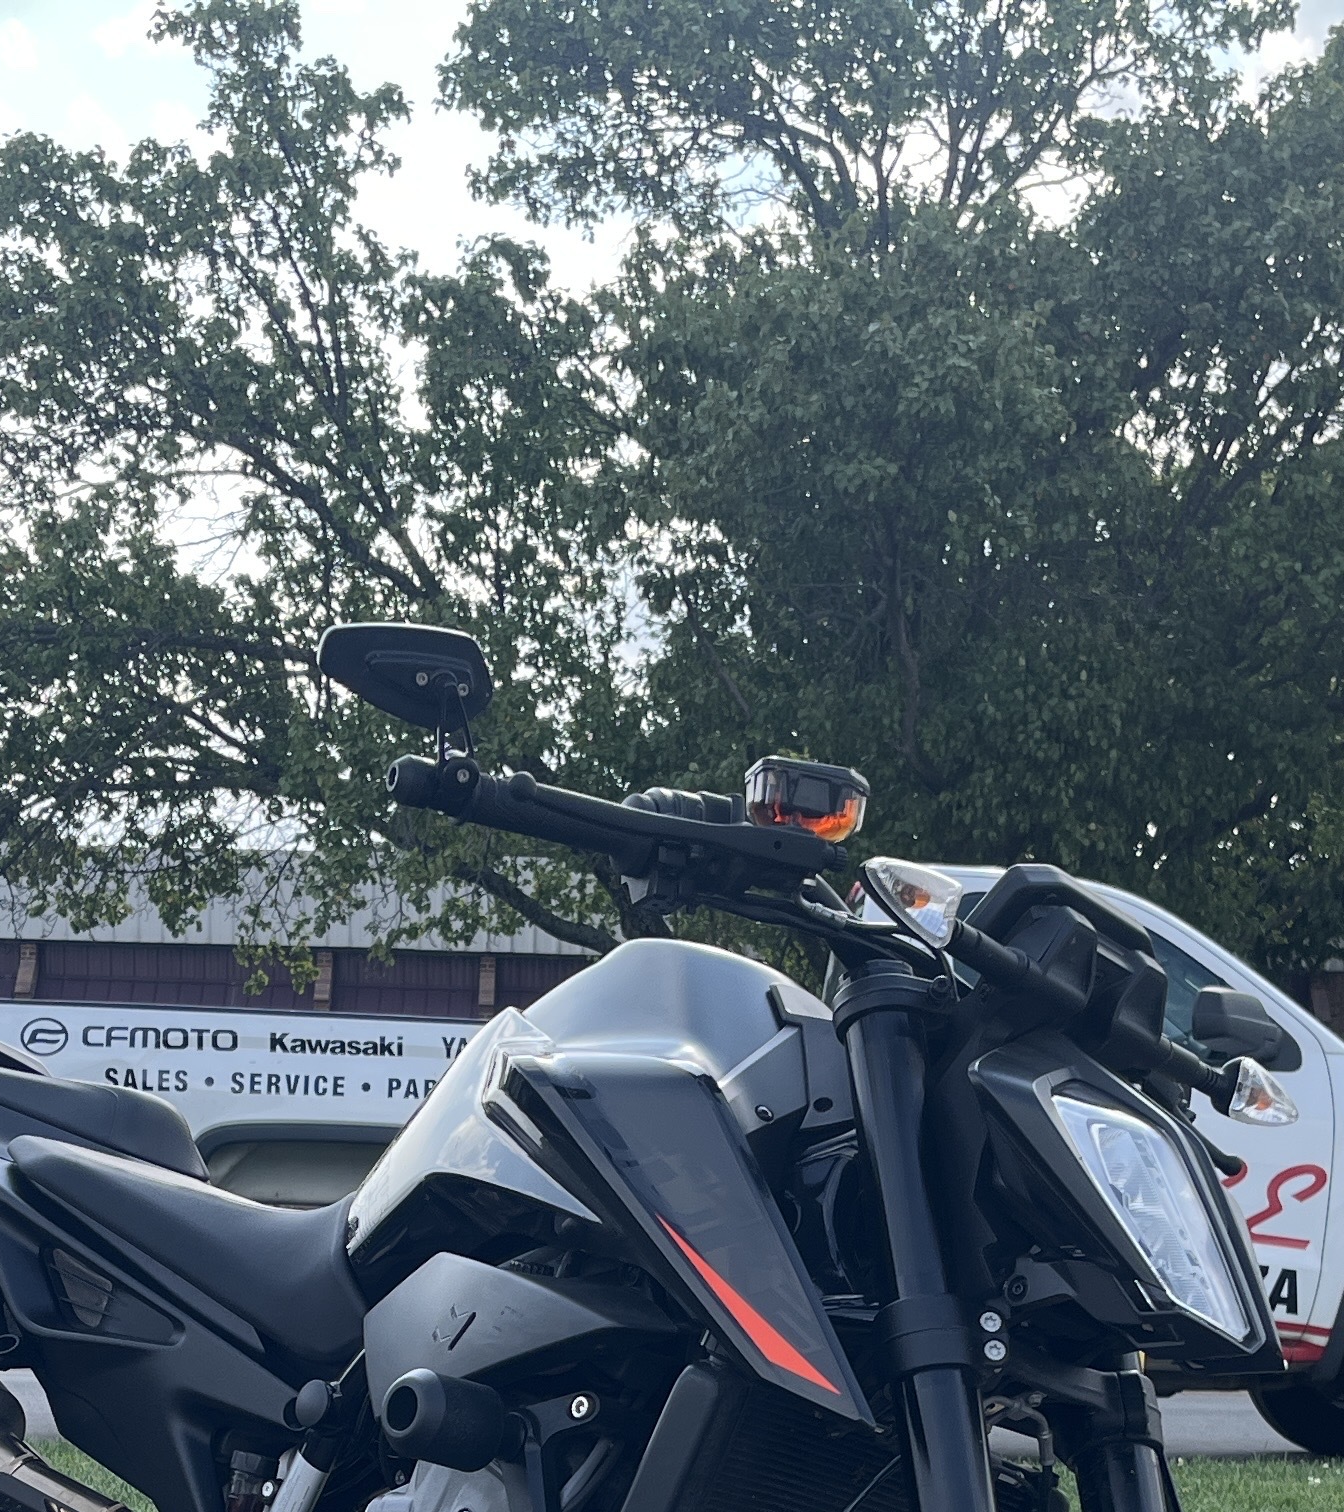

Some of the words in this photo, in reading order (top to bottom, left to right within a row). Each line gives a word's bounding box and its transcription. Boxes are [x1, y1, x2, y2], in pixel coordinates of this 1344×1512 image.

[81, 1025, 239, 1052] CFMOTO
[269, 1033, 404, 1057] Kawasaki
[104, 1067, 188, 1092] SALES
[230, 1072, 346, 1097] SERVICE
